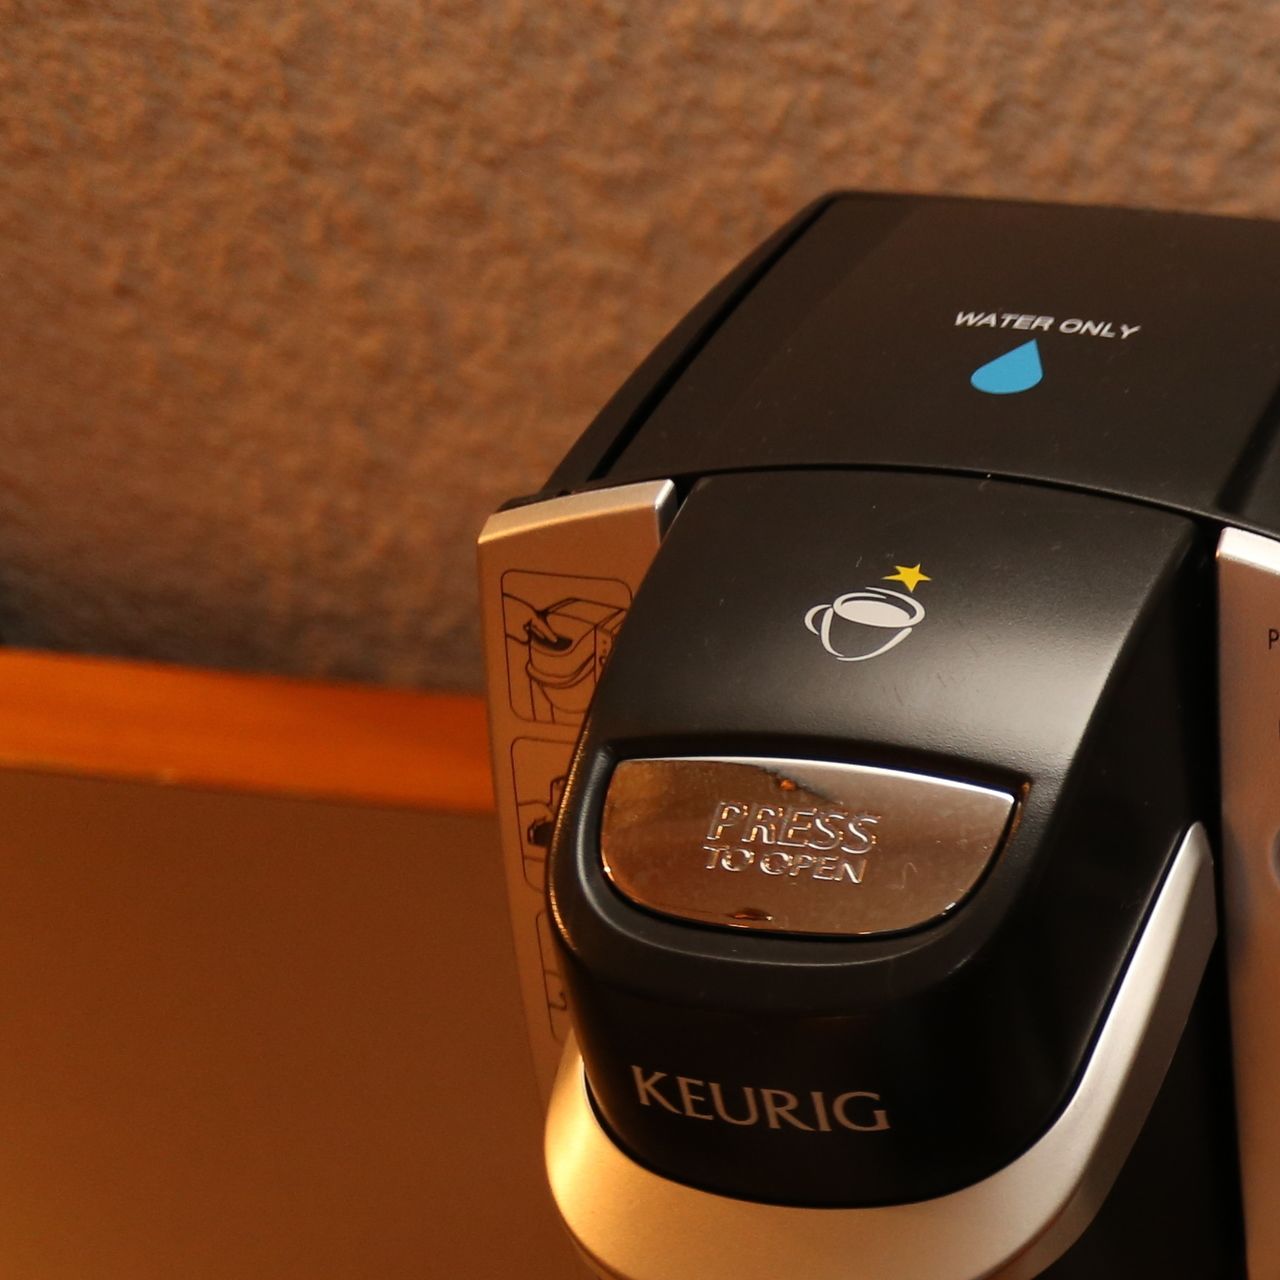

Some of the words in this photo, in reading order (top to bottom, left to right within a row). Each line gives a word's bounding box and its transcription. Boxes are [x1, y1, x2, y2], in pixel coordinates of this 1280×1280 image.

[954, 311, 1055, 332] WATER
[1058, 318, 1142, 340] ONLY
[706, 801, 881, 854] PRESS
[703, 845, 755, 872] TO
[759, 851, 868, 884] OPEN
[630, 1064, 891, 1132] KEURIG
